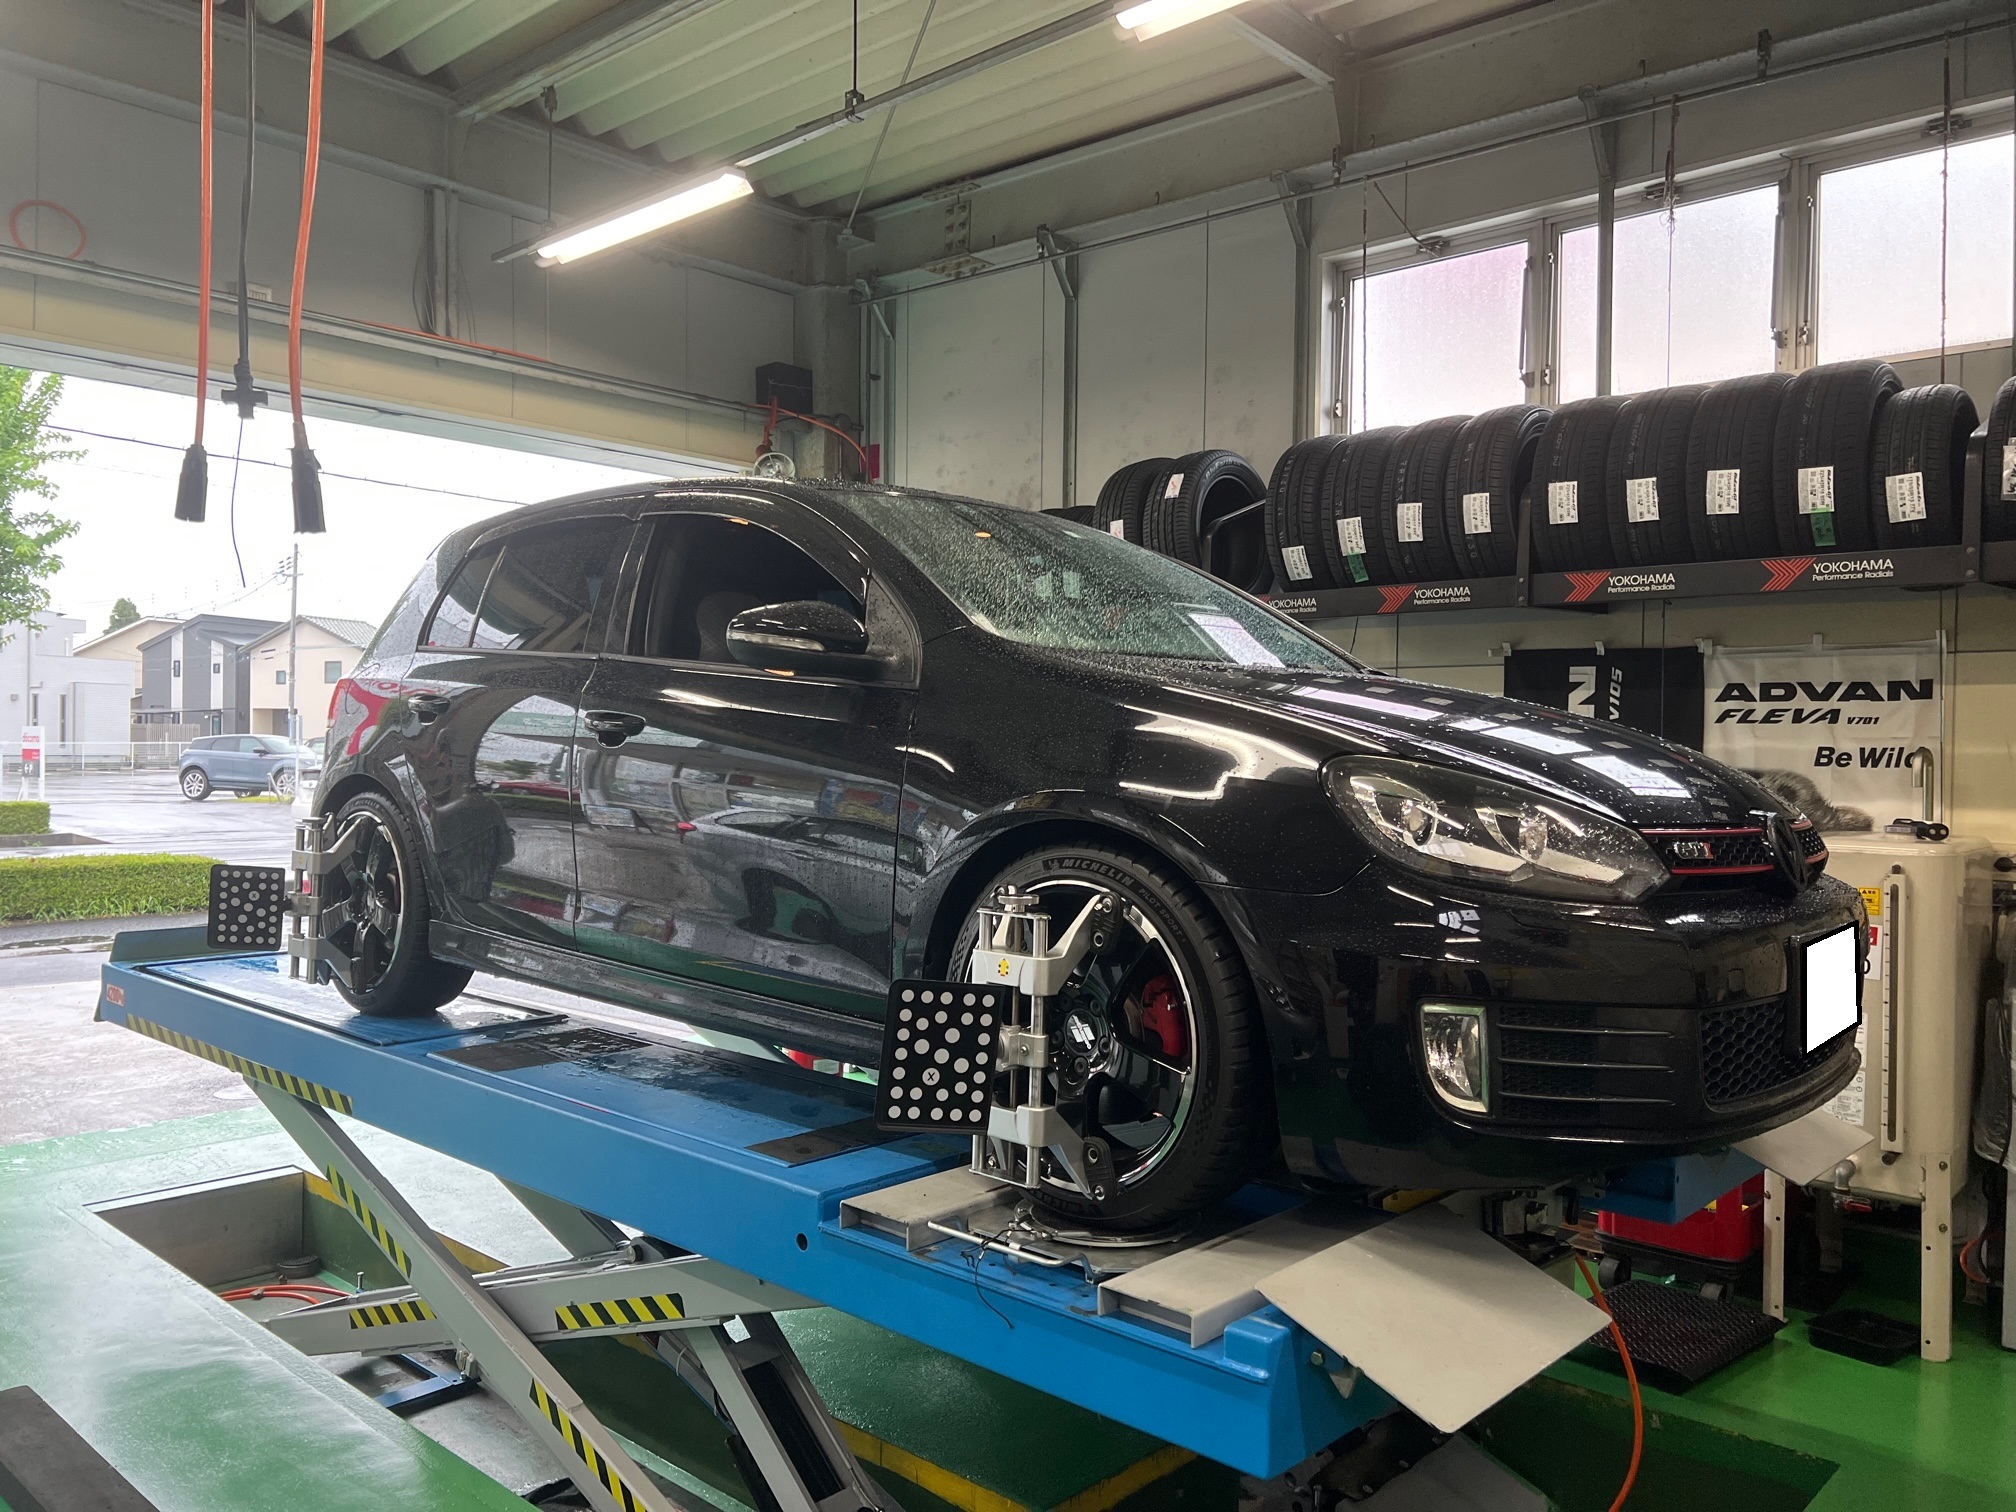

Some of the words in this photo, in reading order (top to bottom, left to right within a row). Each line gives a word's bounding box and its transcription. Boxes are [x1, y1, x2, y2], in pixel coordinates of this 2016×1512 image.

[1813, 558, 1894, 574] YOKOHAMA
[1608, 573, 1676, 587] YOKOHAMA
[1812, 572, 1863, 582] Performance
[1865, 570, 1894, 579] Radials
[1414, 586, 1471, 599] YOKOHAMA
[1607, 586, 1650, 594] Performance
[1651, 583, 1676, 592] Radials
[1268, 597, 1317, 609] YOKOHAMA
[1609, 666, 1623, 721] V105
[1714, 678, 1934, 703] ADVAN
[1714, 708, 1842, 725] FLEVA
[1846, 716, 1881, 725] V701
[1814, 746, 1853, 768] Be
[1673, 841, 1714, 860] GTI
[1062, 858, 1135, 887] MICHELIN
[1138, 888, 1162, 908] PILOT
[1159, 908, 1183, 936] SPORT
